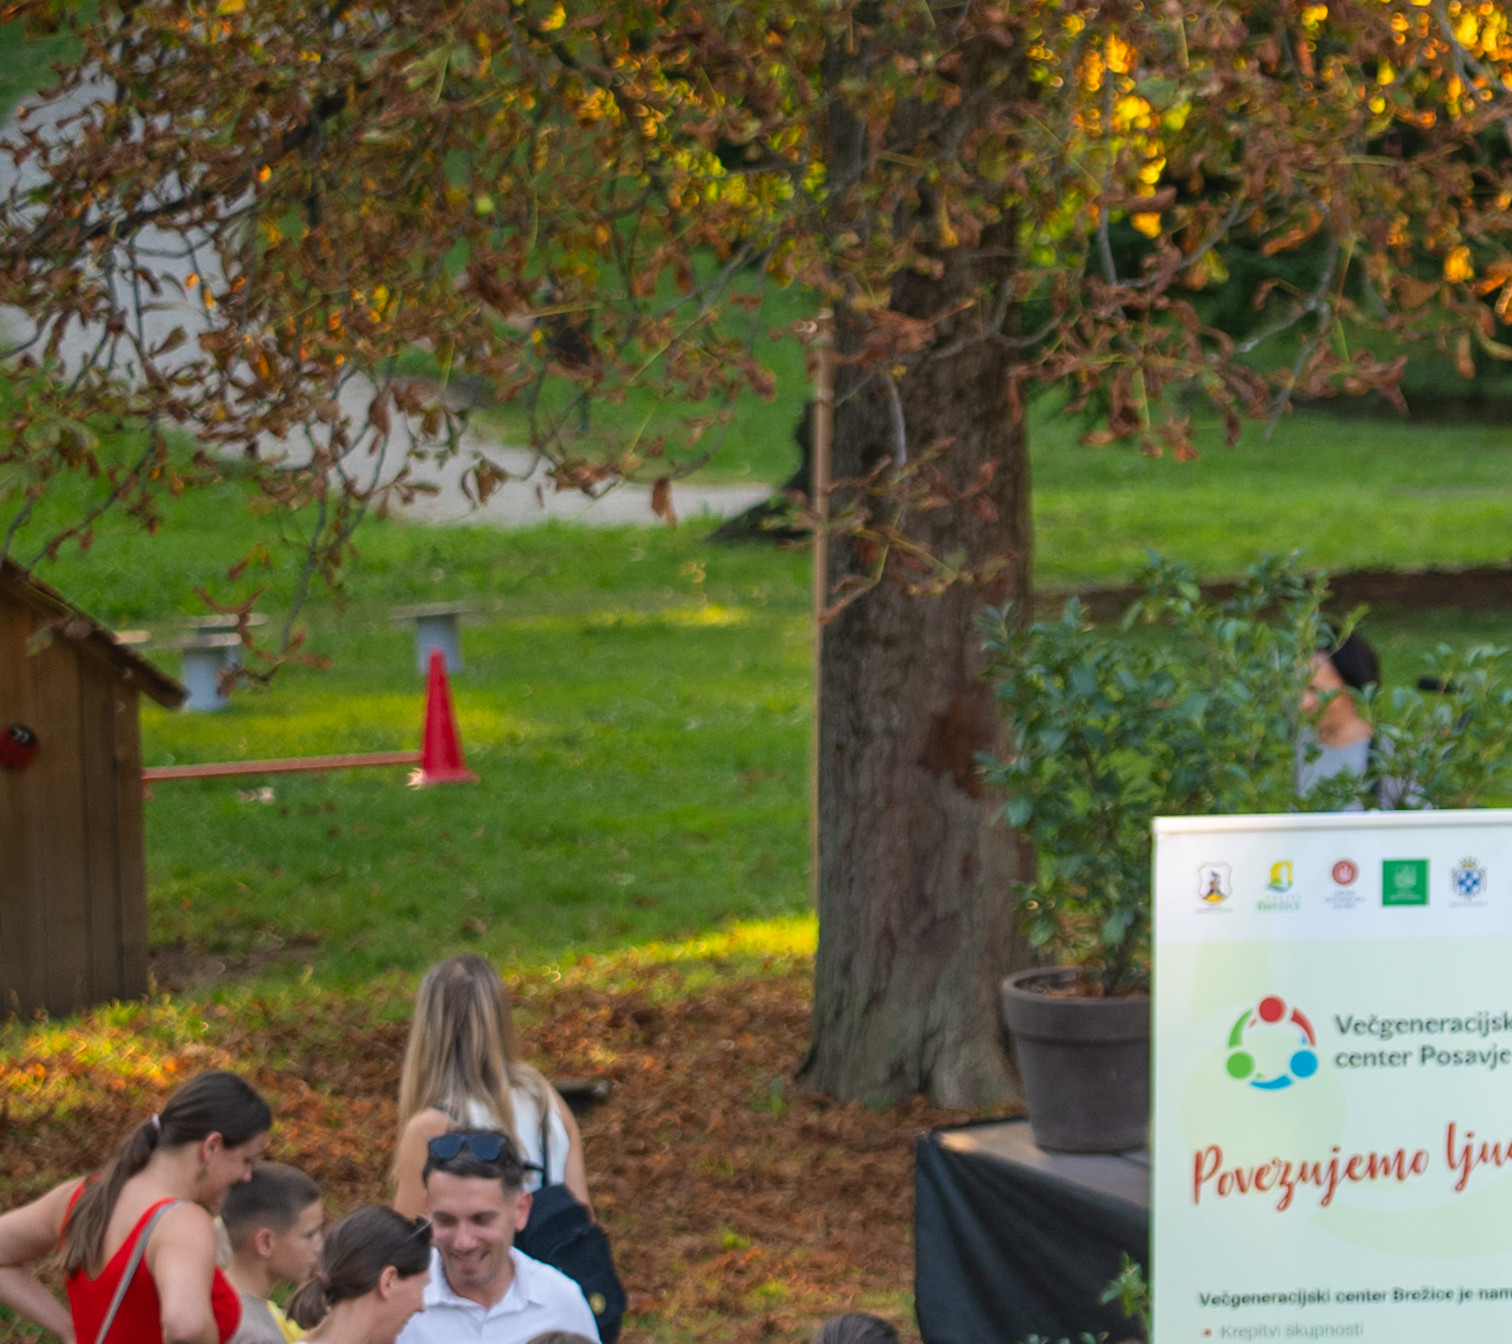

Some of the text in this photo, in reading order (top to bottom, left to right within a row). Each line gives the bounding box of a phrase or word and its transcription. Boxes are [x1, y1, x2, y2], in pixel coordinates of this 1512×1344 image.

[1336, 1047, 1412, 1069] center
[1193, 1144, 1429, 1212] Povezujemo
[1200, 1289, 1331, 1310] Večgeneracijski
[1336, 1290, 1387, 1304] center
[1393, 1286, 1454, 1301] Brežice
[1459, 1287, 1473, 1305] je
[1220, 1322, 1364, 1342] Krepitvi skupnosti
